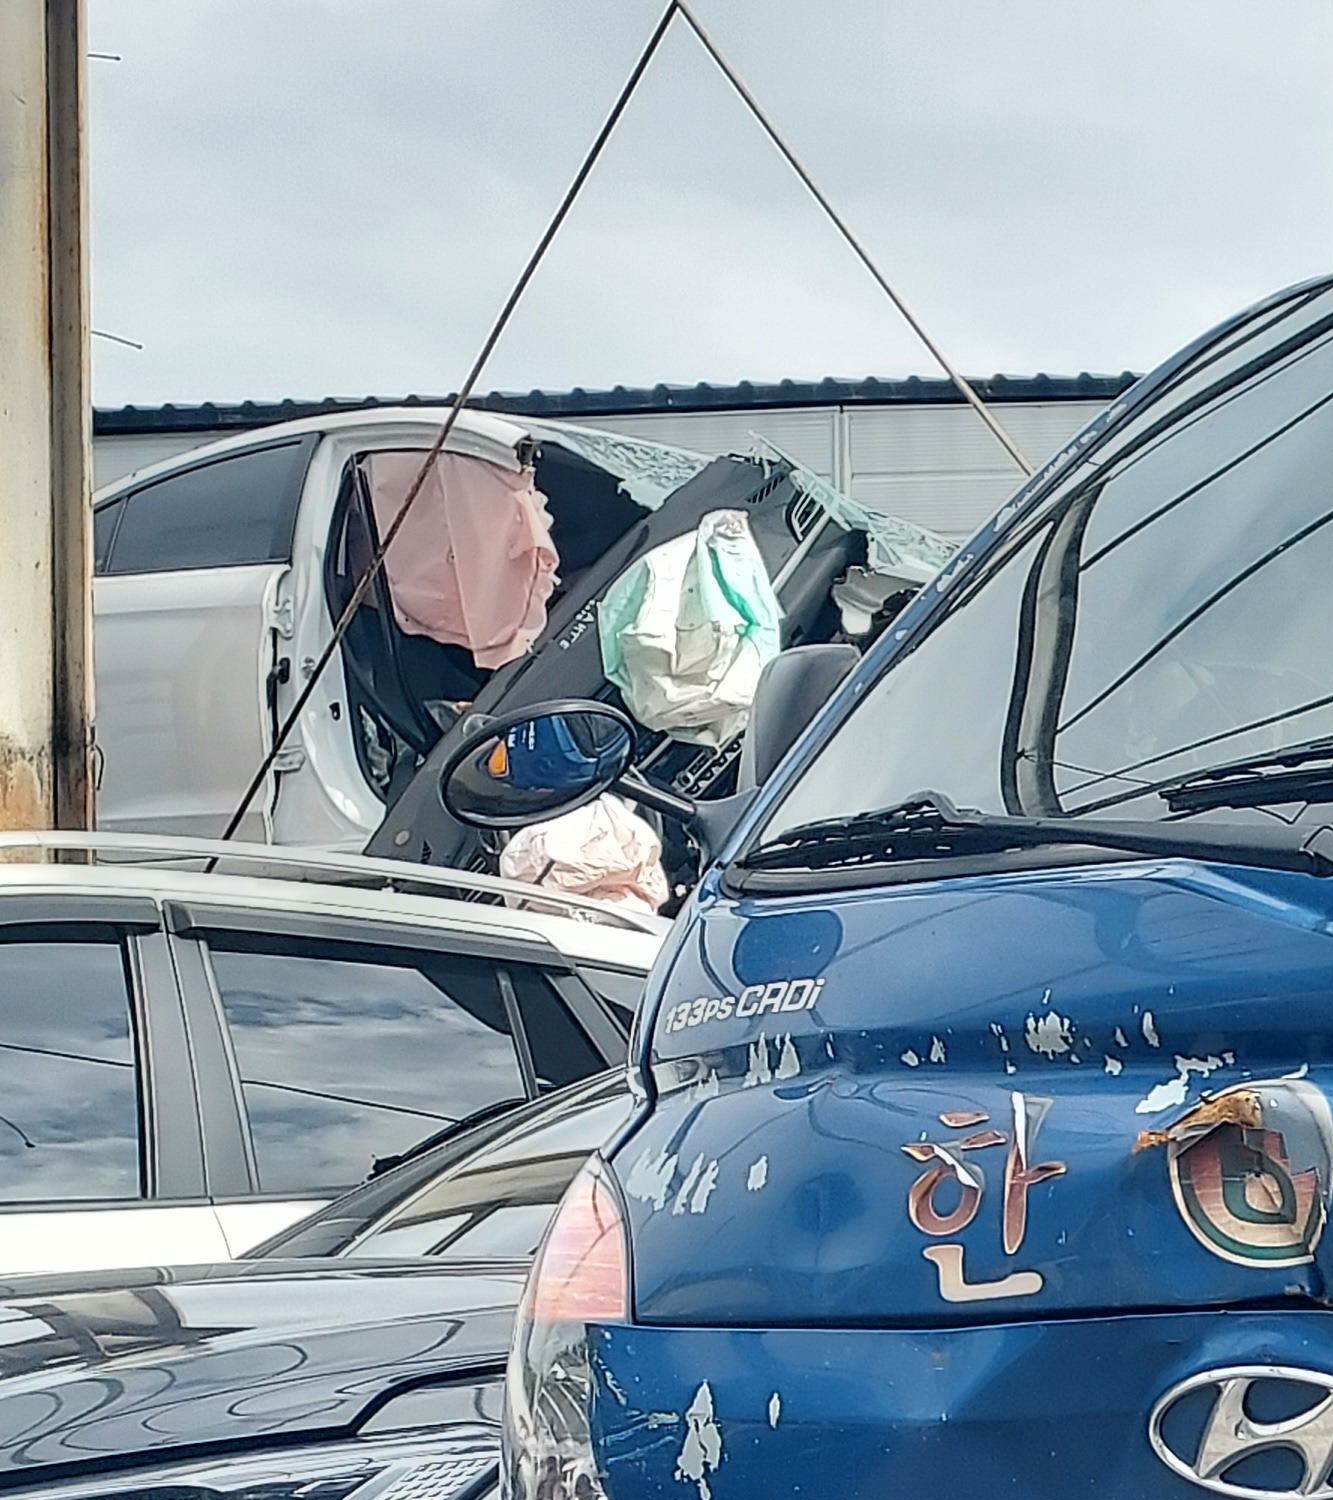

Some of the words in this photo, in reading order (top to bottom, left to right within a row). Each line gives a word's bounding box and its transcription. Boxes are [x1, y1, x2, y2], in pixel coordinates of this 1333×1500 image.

[666, 997, 736, 1033] 133ps
[736, 979, 825, 1018] CRDi
[902, 1090, 1067, 1304] 한
